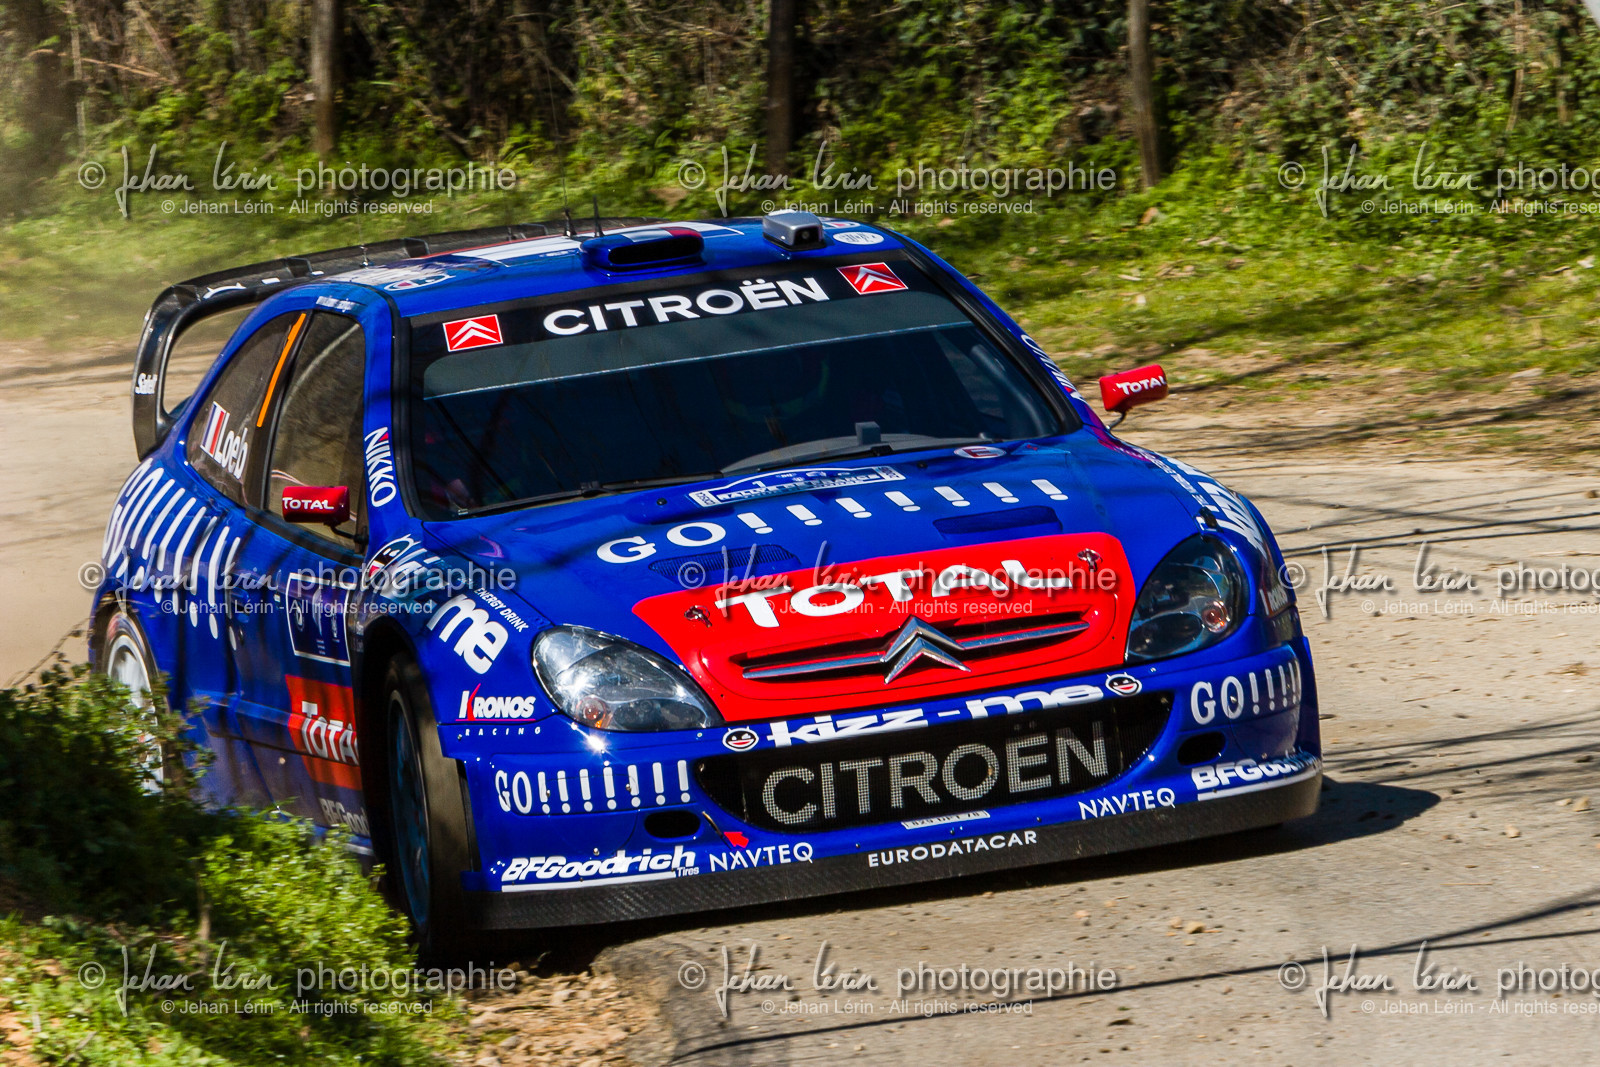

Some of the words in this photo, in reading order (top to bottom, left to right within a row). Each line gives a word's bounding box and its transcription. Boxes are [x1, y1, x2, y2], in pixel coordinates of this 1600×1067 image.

[543, 277, 830, 336] CITROËN
[213, 412, 248, 480] Loeb
[364, 427, 397, 508] NIKKO
[282, 496, 335, 510] TOTAL
[474, 587, 506, 612] ENERGY
[499, 606, 530, 633] DRINK
[715, 560, 1073, 628] TOTAL
[458, 683, 537, 720] KRONOS
[302, 700, 359, 766] TOTA
[762, 720, 1109, 825] CITROËN
[1078, 787, 1176, 821] NAVTEQ
[501, 845, 697, 882] BFGoodrich
[676, 866, 700, 877] Tires
[708, 842, 814, 873] NAVTEQ
[867, 830, 1038, 868] EURODATACAR
